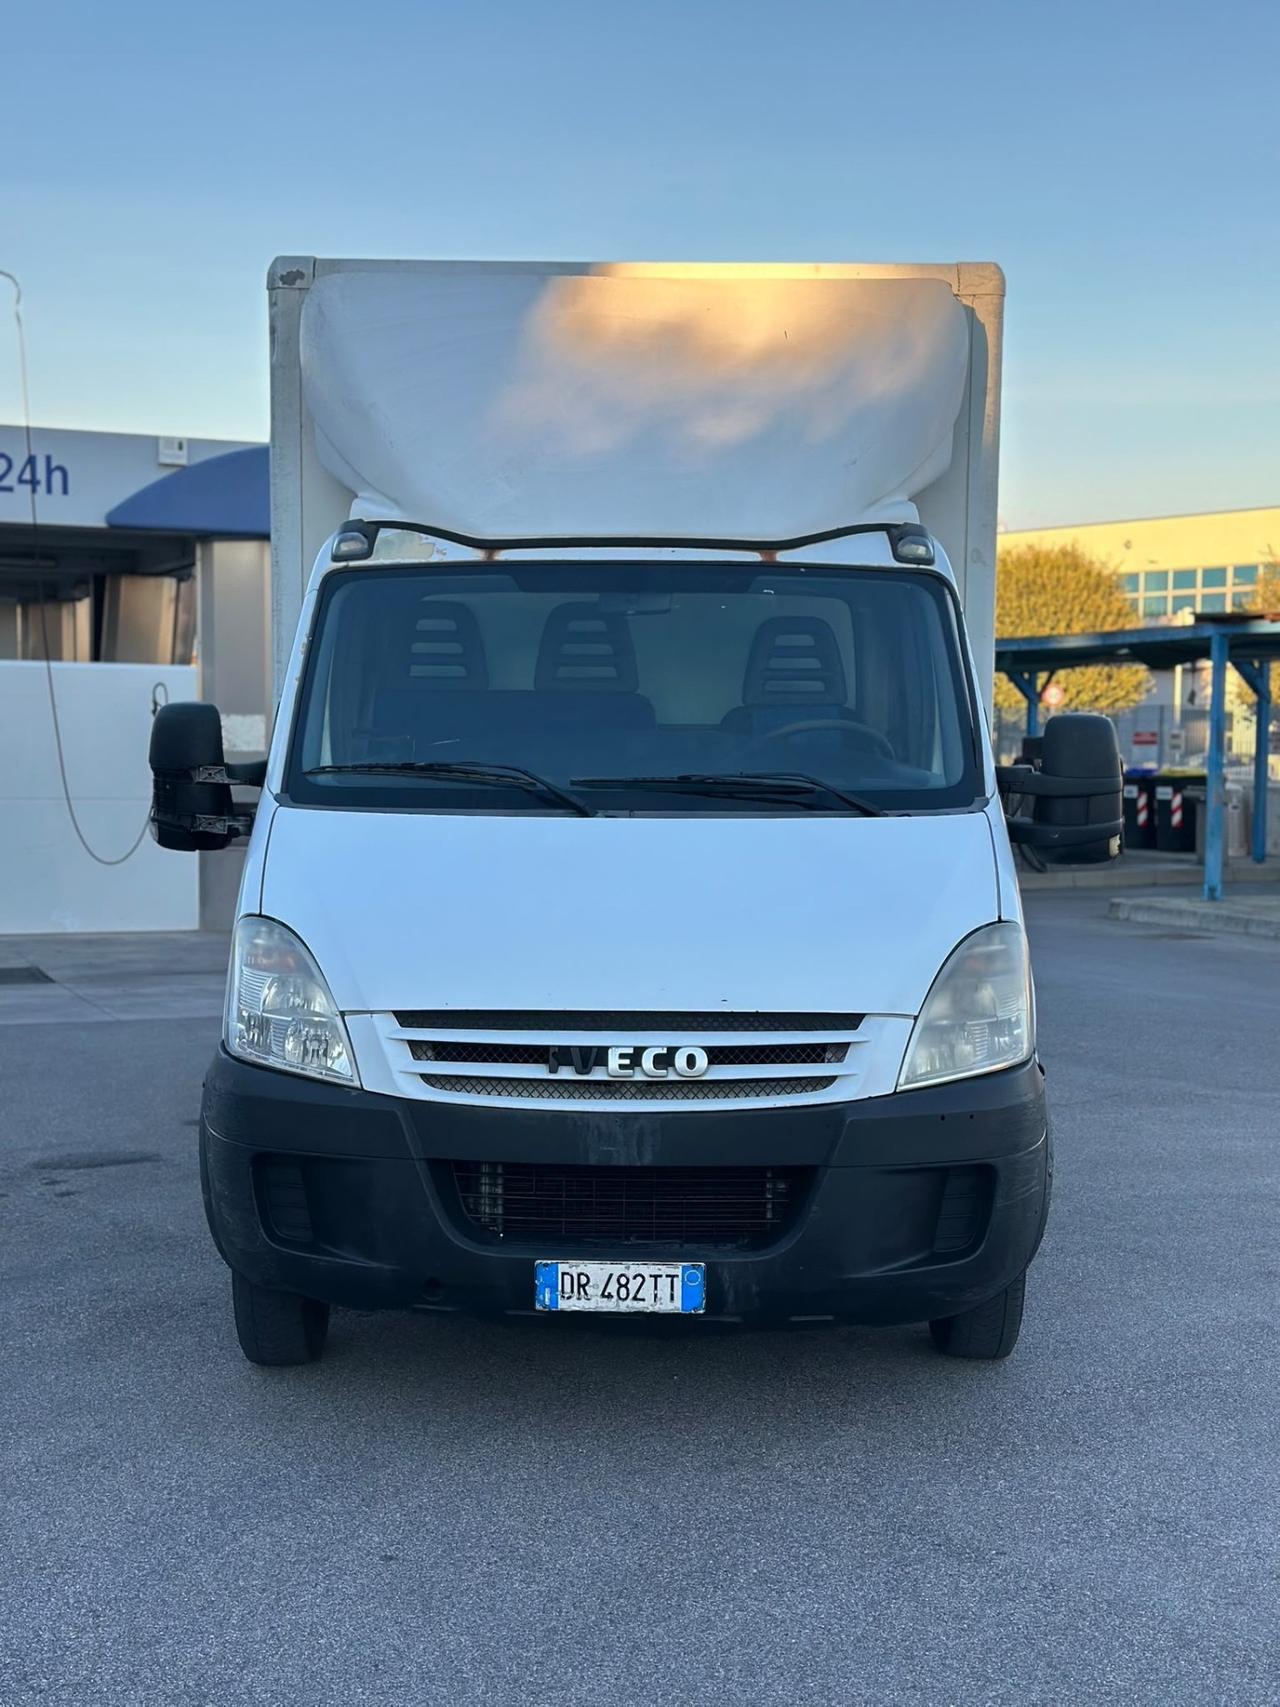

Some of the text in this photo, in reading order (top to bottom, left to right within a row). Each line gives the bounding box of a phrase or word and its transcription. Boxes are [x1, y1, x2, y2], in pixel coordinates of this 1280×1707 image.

[0, 453, 69, 495] 24h
[561, 1271, 680, 1303] DR 482TT
